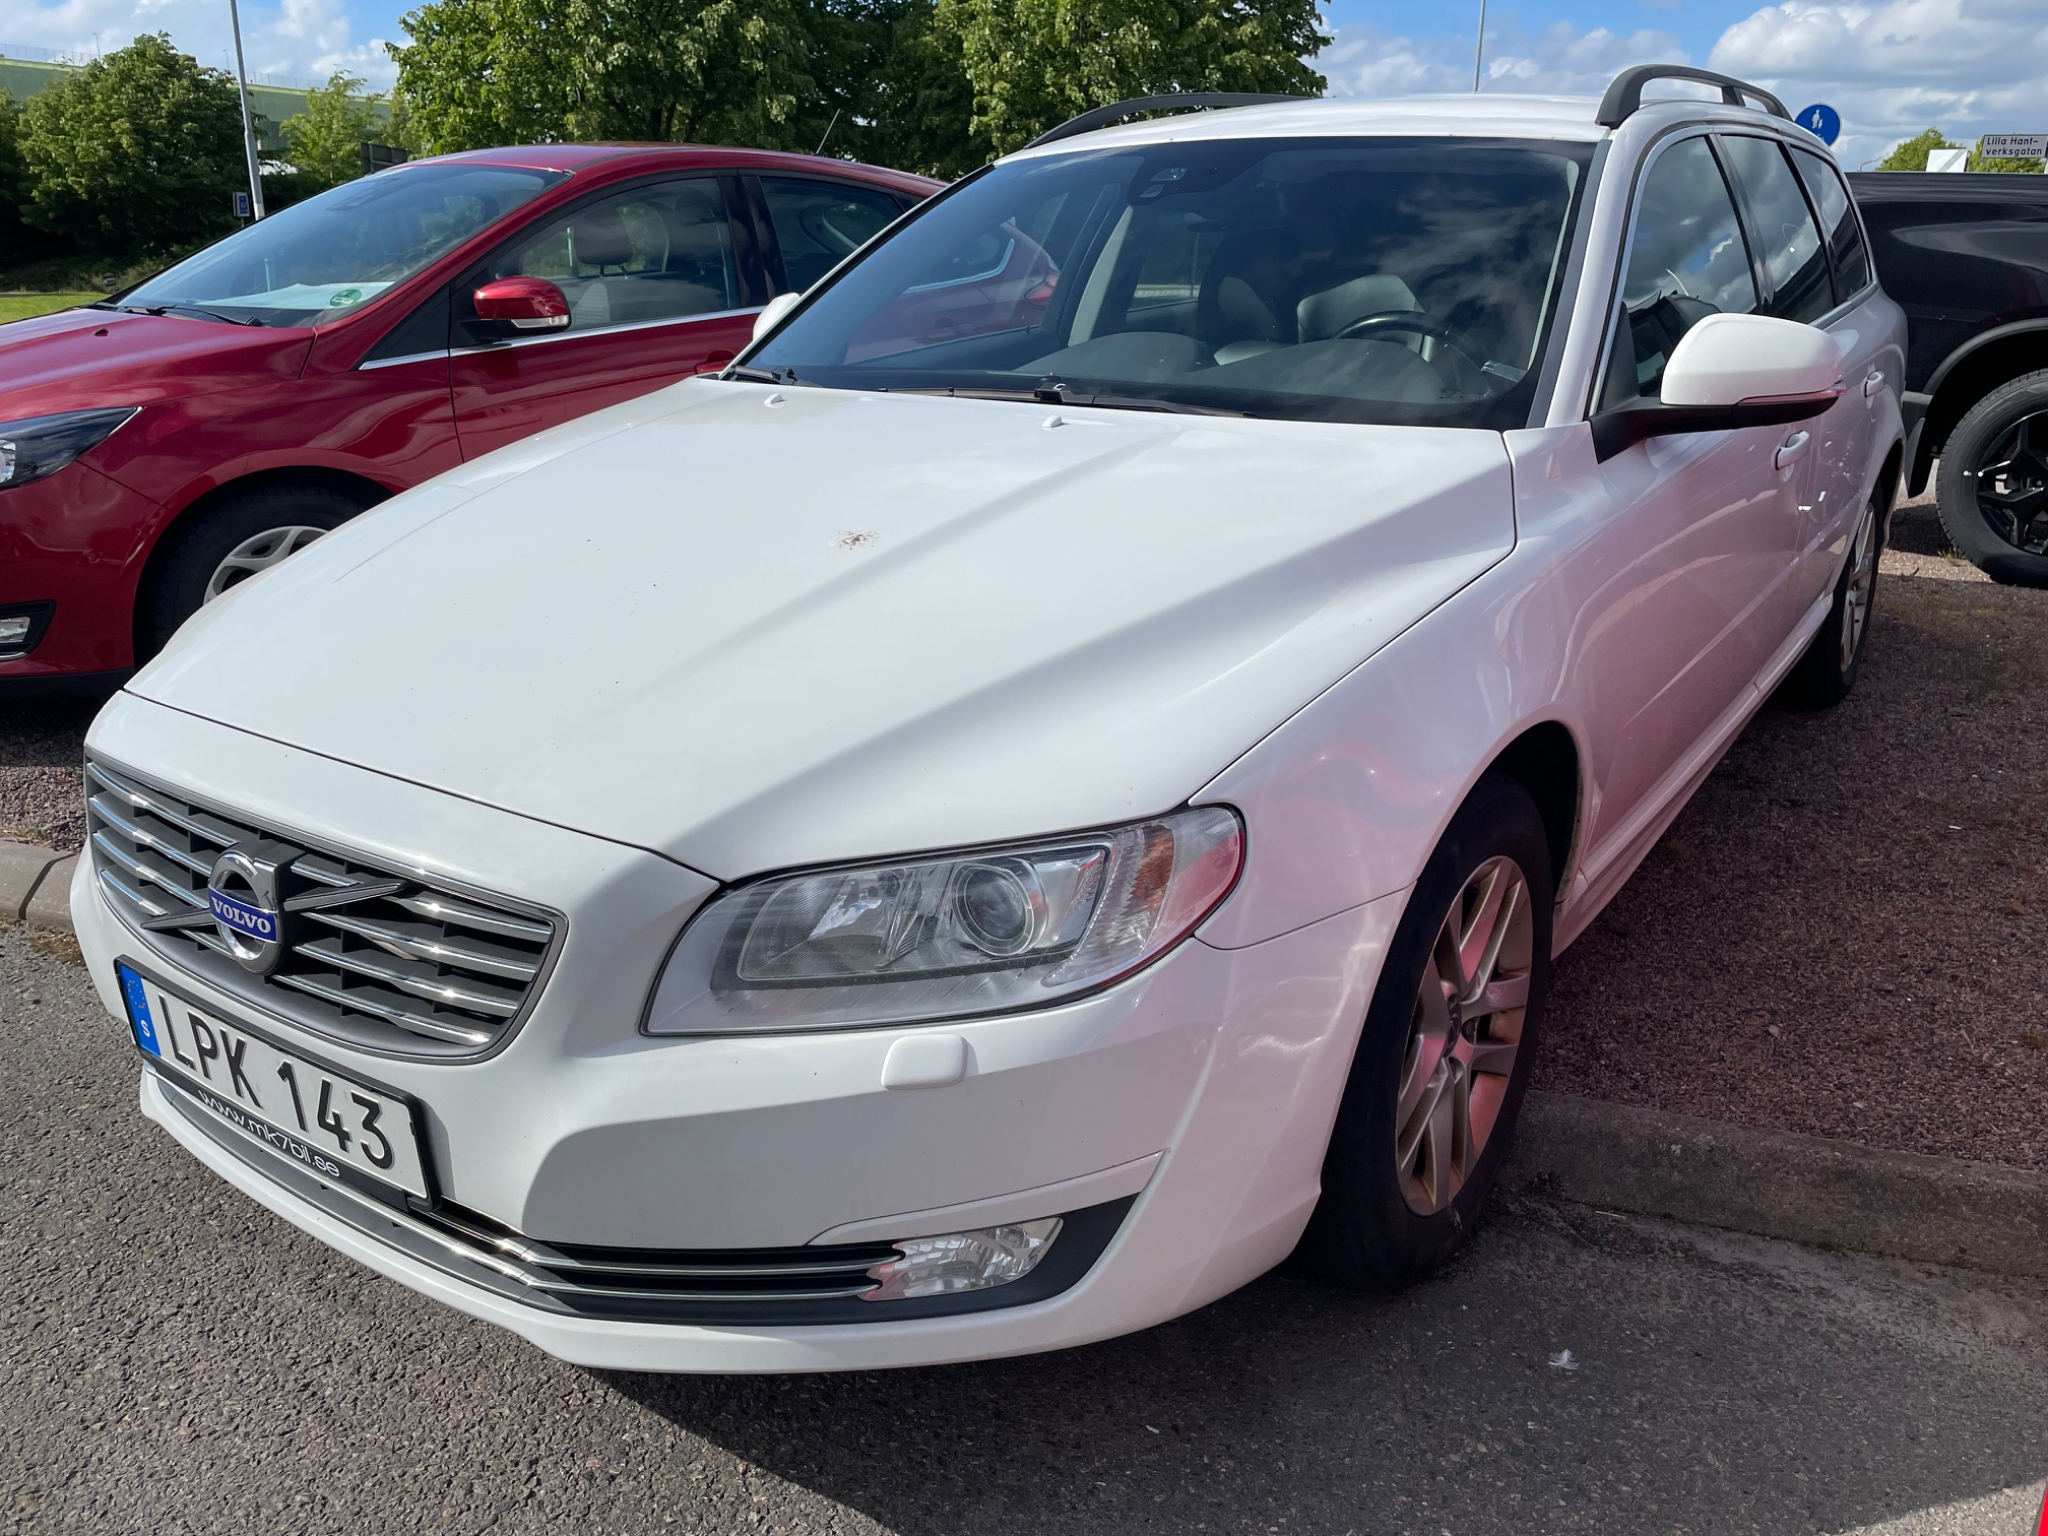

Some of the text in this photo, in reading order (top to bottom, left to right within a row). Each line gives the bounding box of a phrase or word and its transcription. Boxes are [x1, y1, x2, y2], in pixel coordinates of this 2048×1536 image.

[1985, 147, 2042, 157] verksgatan
[1987, 137, 2038, 145] Lilla Hant-
[211, 896, 271, 933] VOLVO
[141, 1020, 151, 1038] S
[158, 993, 394, 1170] LPK 143
[198, 1089, 340, 1177] www.mk7bil.se
